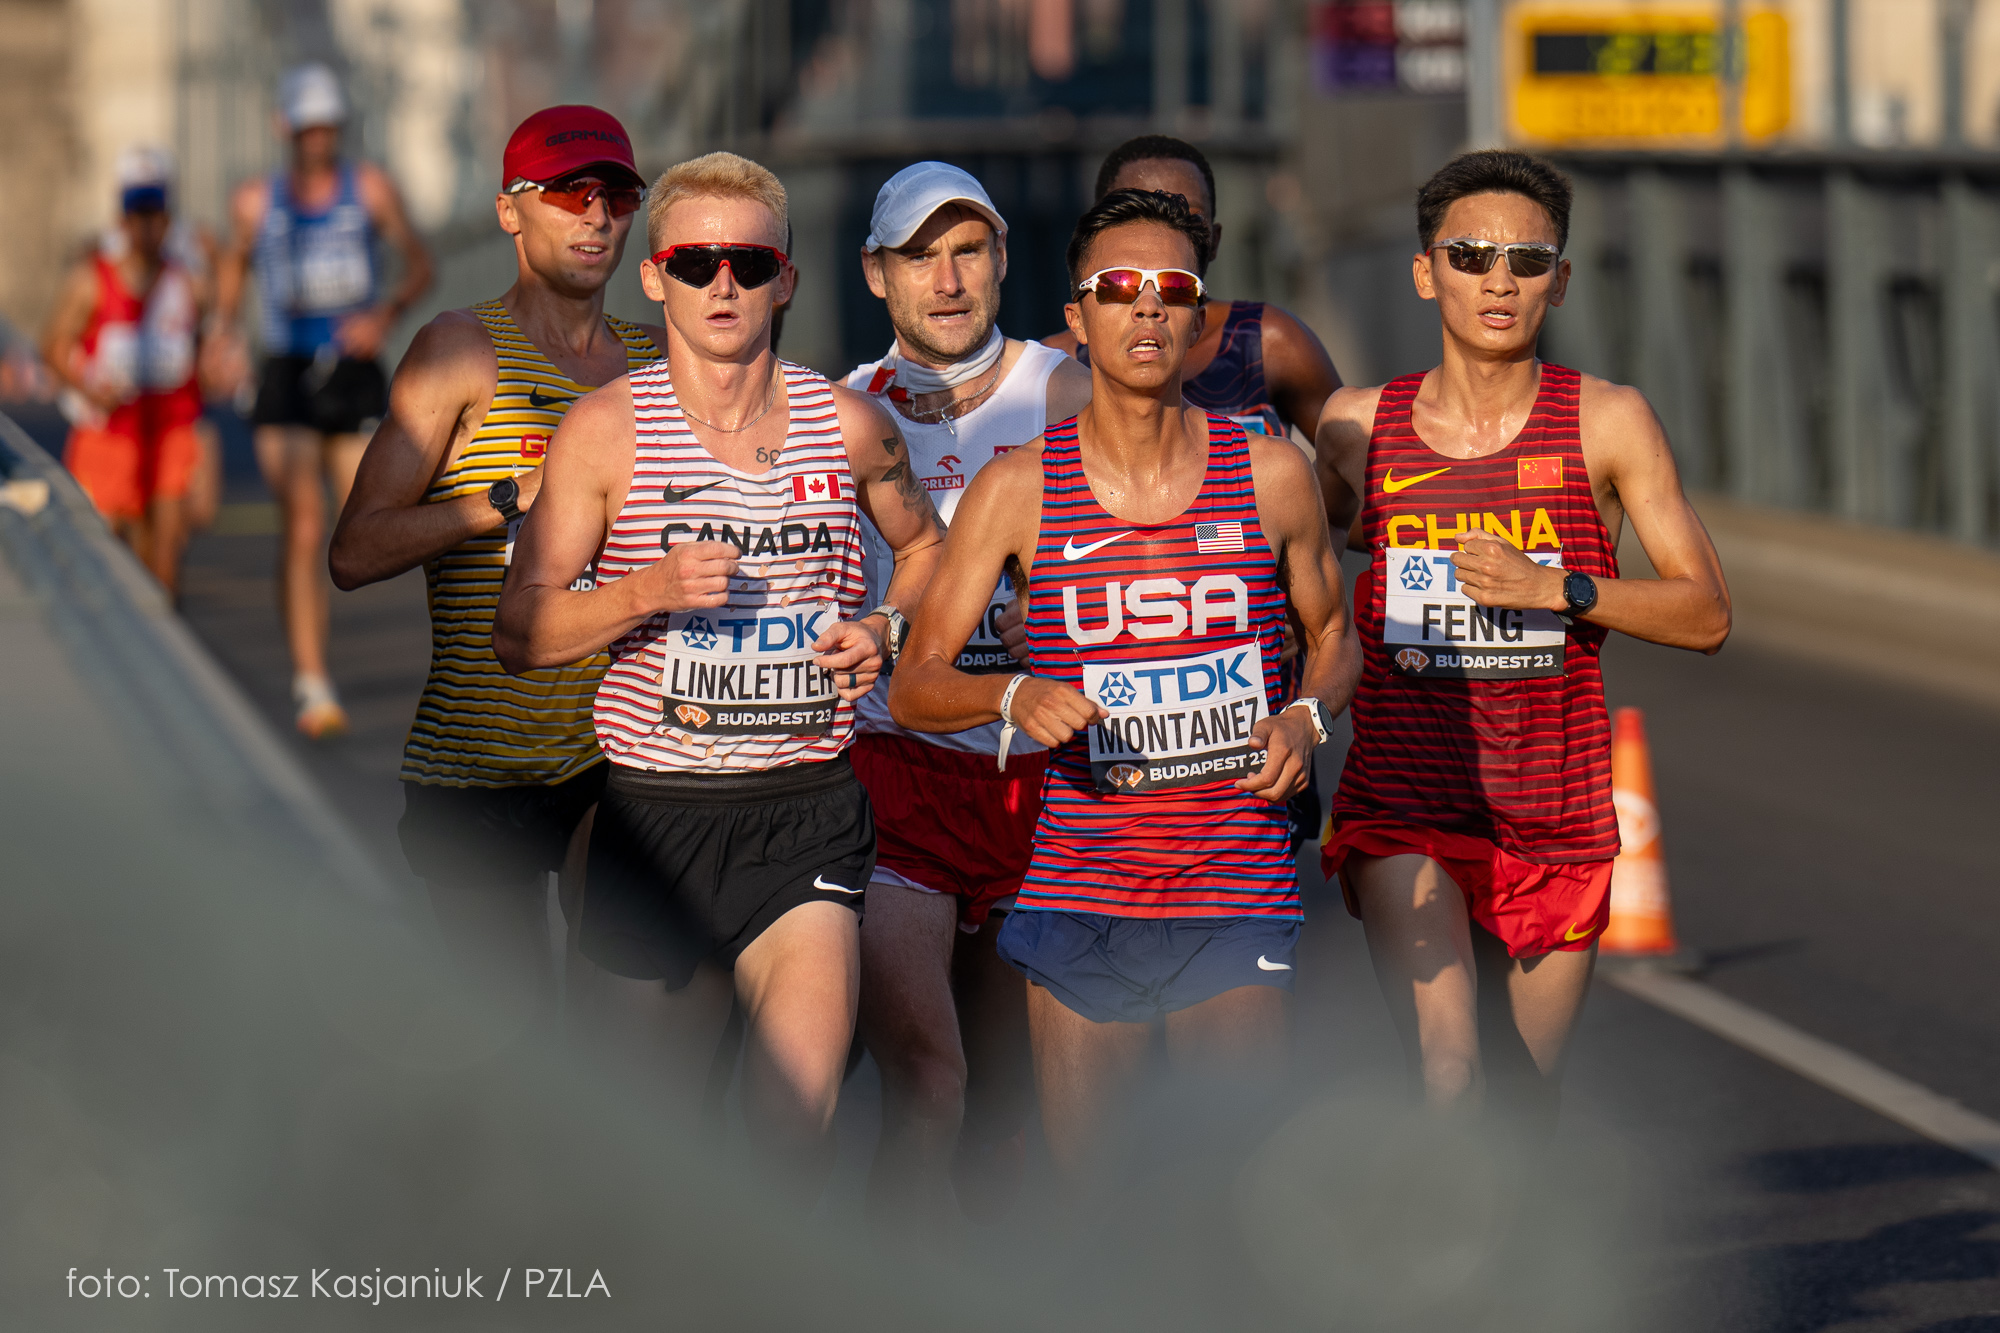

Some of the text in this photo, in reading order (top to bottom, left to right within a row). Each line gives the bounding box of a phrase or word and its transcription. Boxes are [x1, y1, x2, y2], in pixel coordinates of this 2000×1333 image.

[546, 130, 625, 148] GERMANY
[921, 476, 962, 489] ORLEN
[660, 522, 834, 557] CANADA
[1062, 573, 1249, 646] USA
[1421, 603, 1524, 643] FENG
[718, 610, 826, 653] TDK
[670, 657, 834, 701] LINKLETTER
[1133, 651, 1254, 705] TDK
[1435, 654, 1554, 669] BUDAPEST 23
[716, 708, 832, 726] BUDAPEST 23
[1097, 696, 1260, 755] MONTANEZ
[1149, 749, 1268, 782] BUDAPEST 23
